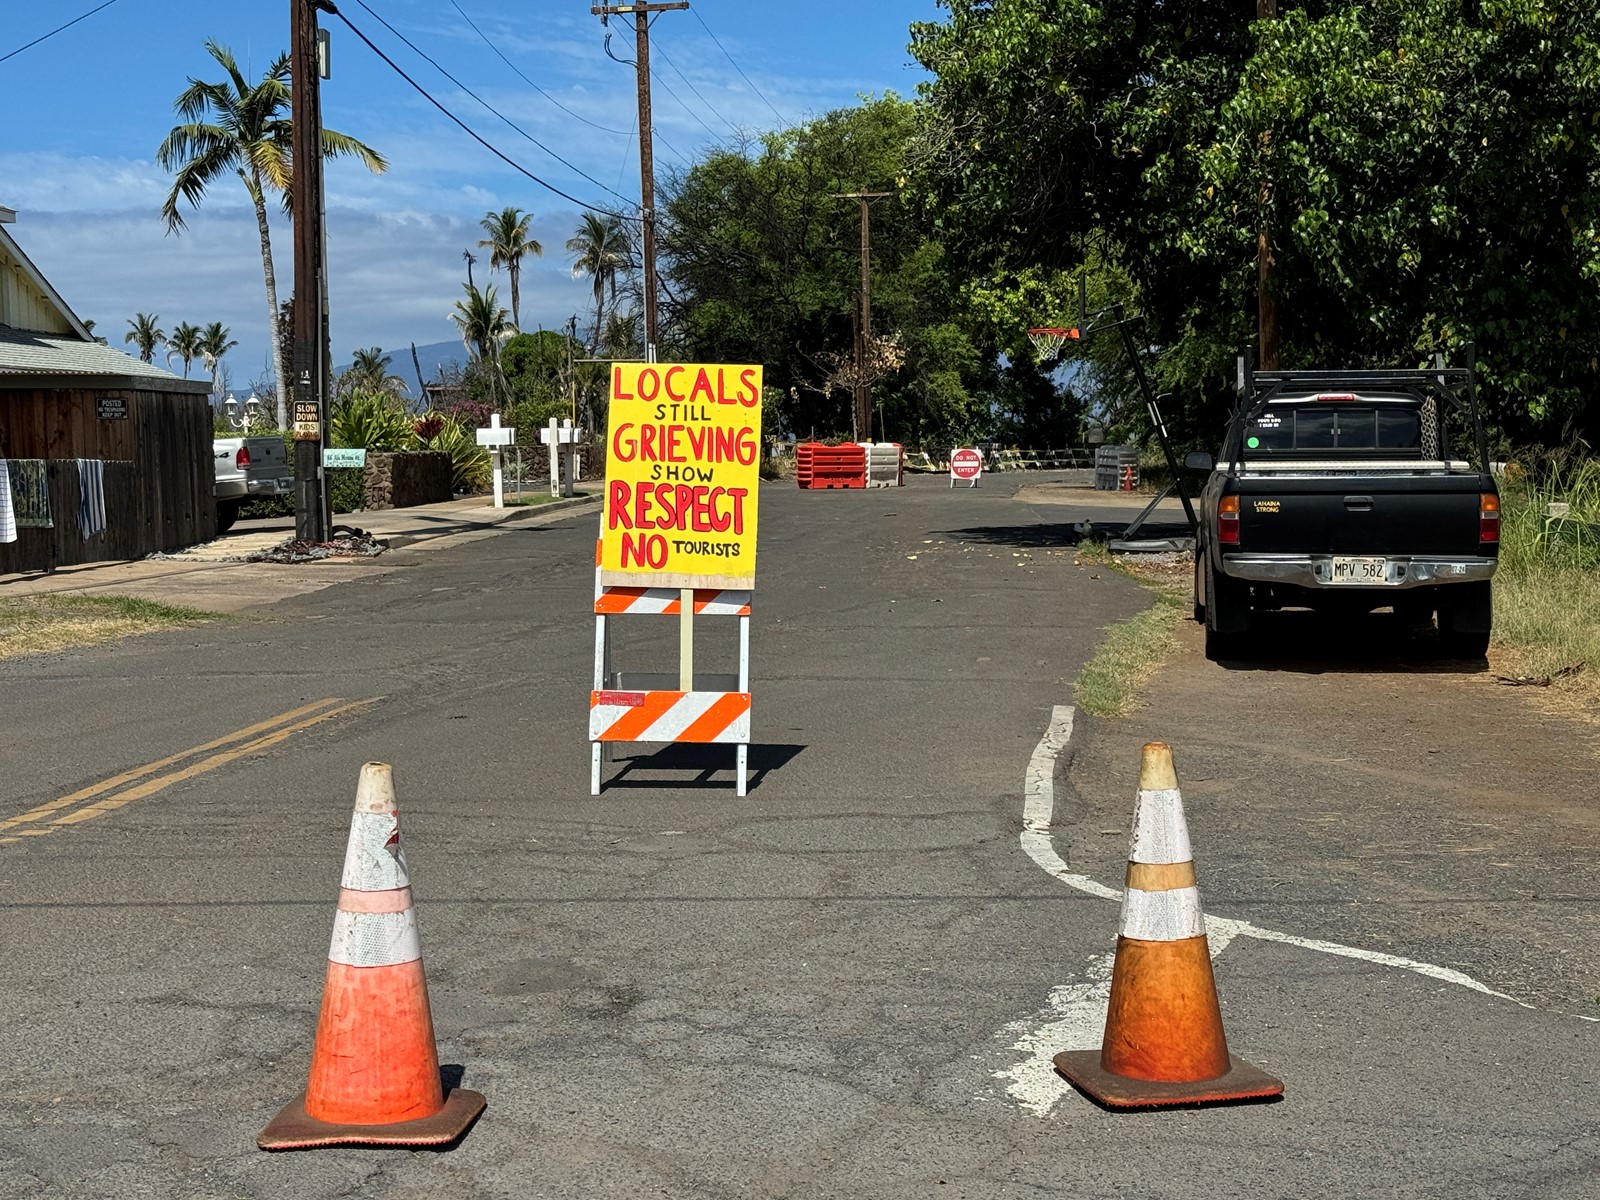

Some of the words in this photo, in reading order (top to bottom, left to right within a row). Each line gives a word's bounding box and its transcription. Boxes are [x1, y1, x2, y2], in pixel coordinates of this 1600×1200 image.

[613, 366, 759, 408] LOCALS
[296, 404, 317, 412] SLOW
[296, 413, 318, 421] DOWN
[654, 404, 712, 421] STILL
[613, 423, 757, 466] GRIEVING
[650, 464, 714, 482] SHOW
[609, 480, 748, 535] RESPECT
[621, 532, 669, 569] NO
[672, 540, 741, 558] TOURISTS
[1334, 563, 1356, 577] MPV
[1362, 563, 1383, 578] 582
